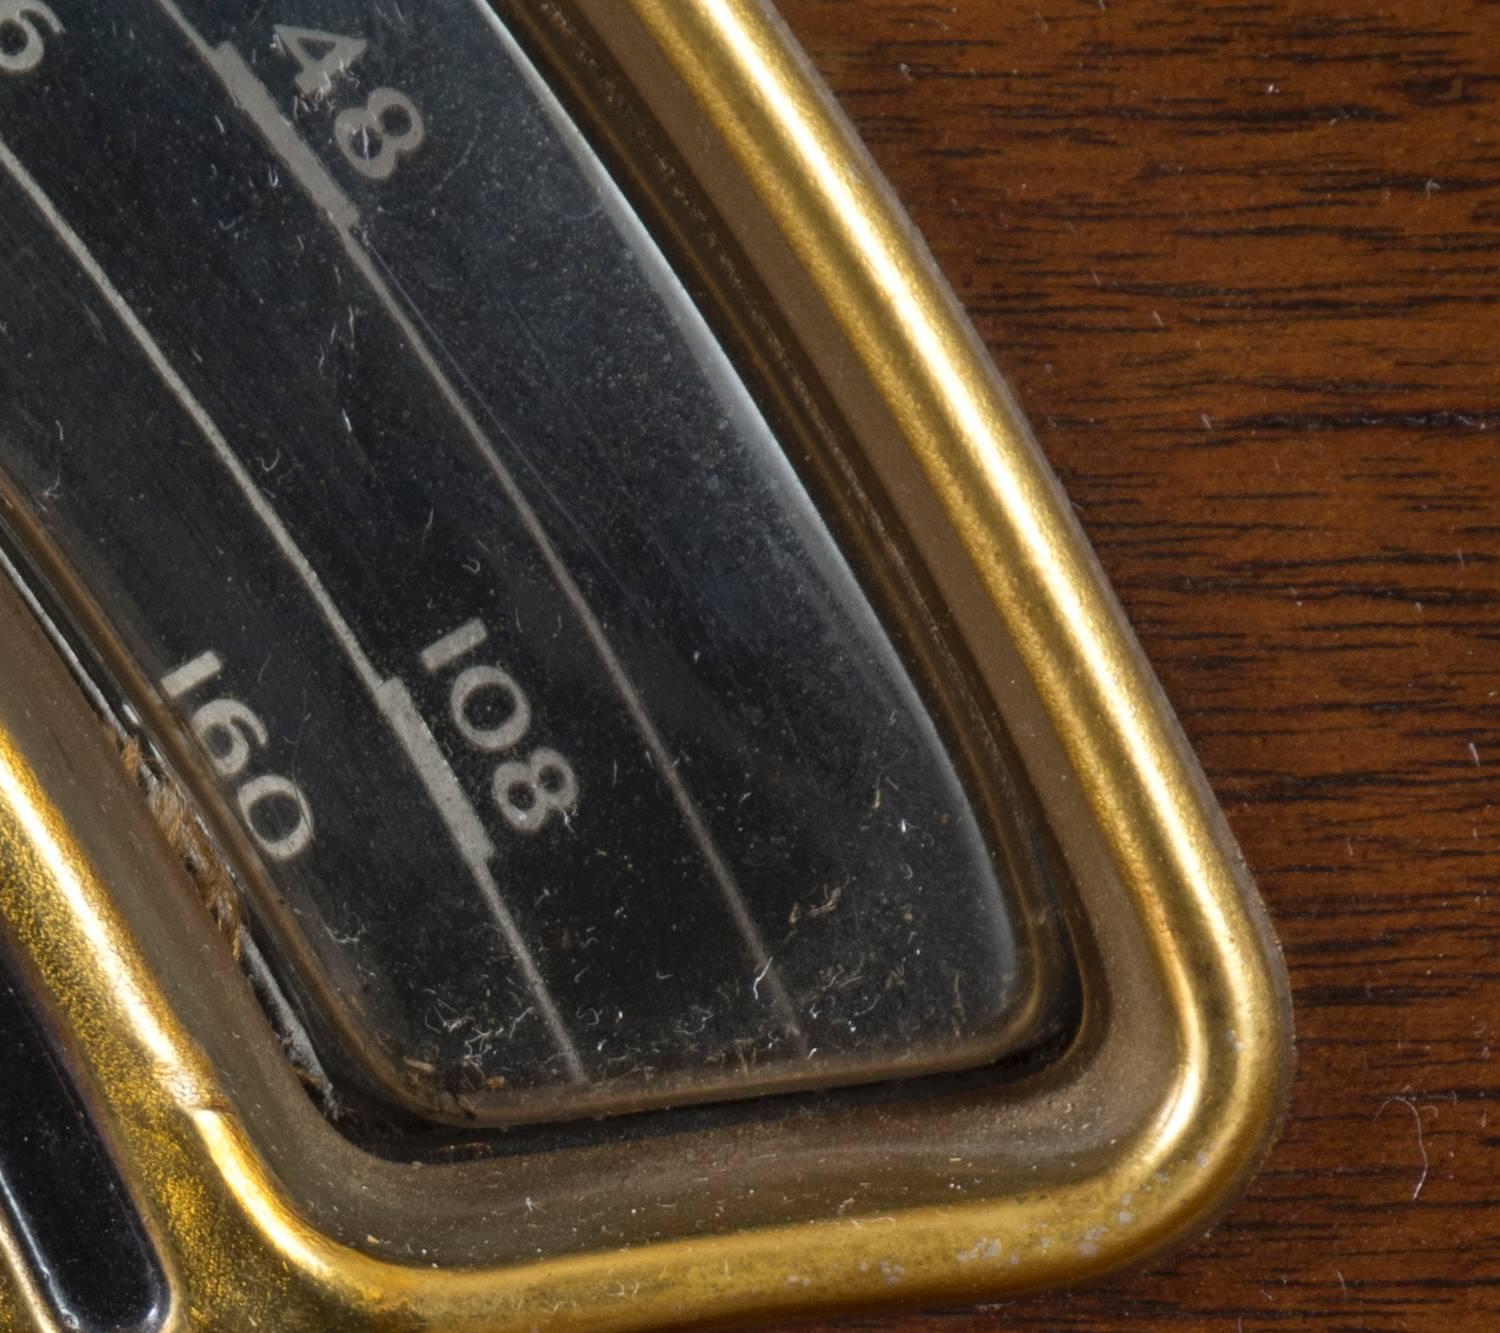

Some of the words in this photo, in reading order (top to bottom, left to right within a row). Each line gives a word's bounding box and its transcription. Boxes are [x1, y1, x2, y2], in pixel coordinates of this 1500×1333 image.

[273, 22, 426, 181] 48
[160, 650, 316, 861] 160
[420, 617, 579, 833] 108
